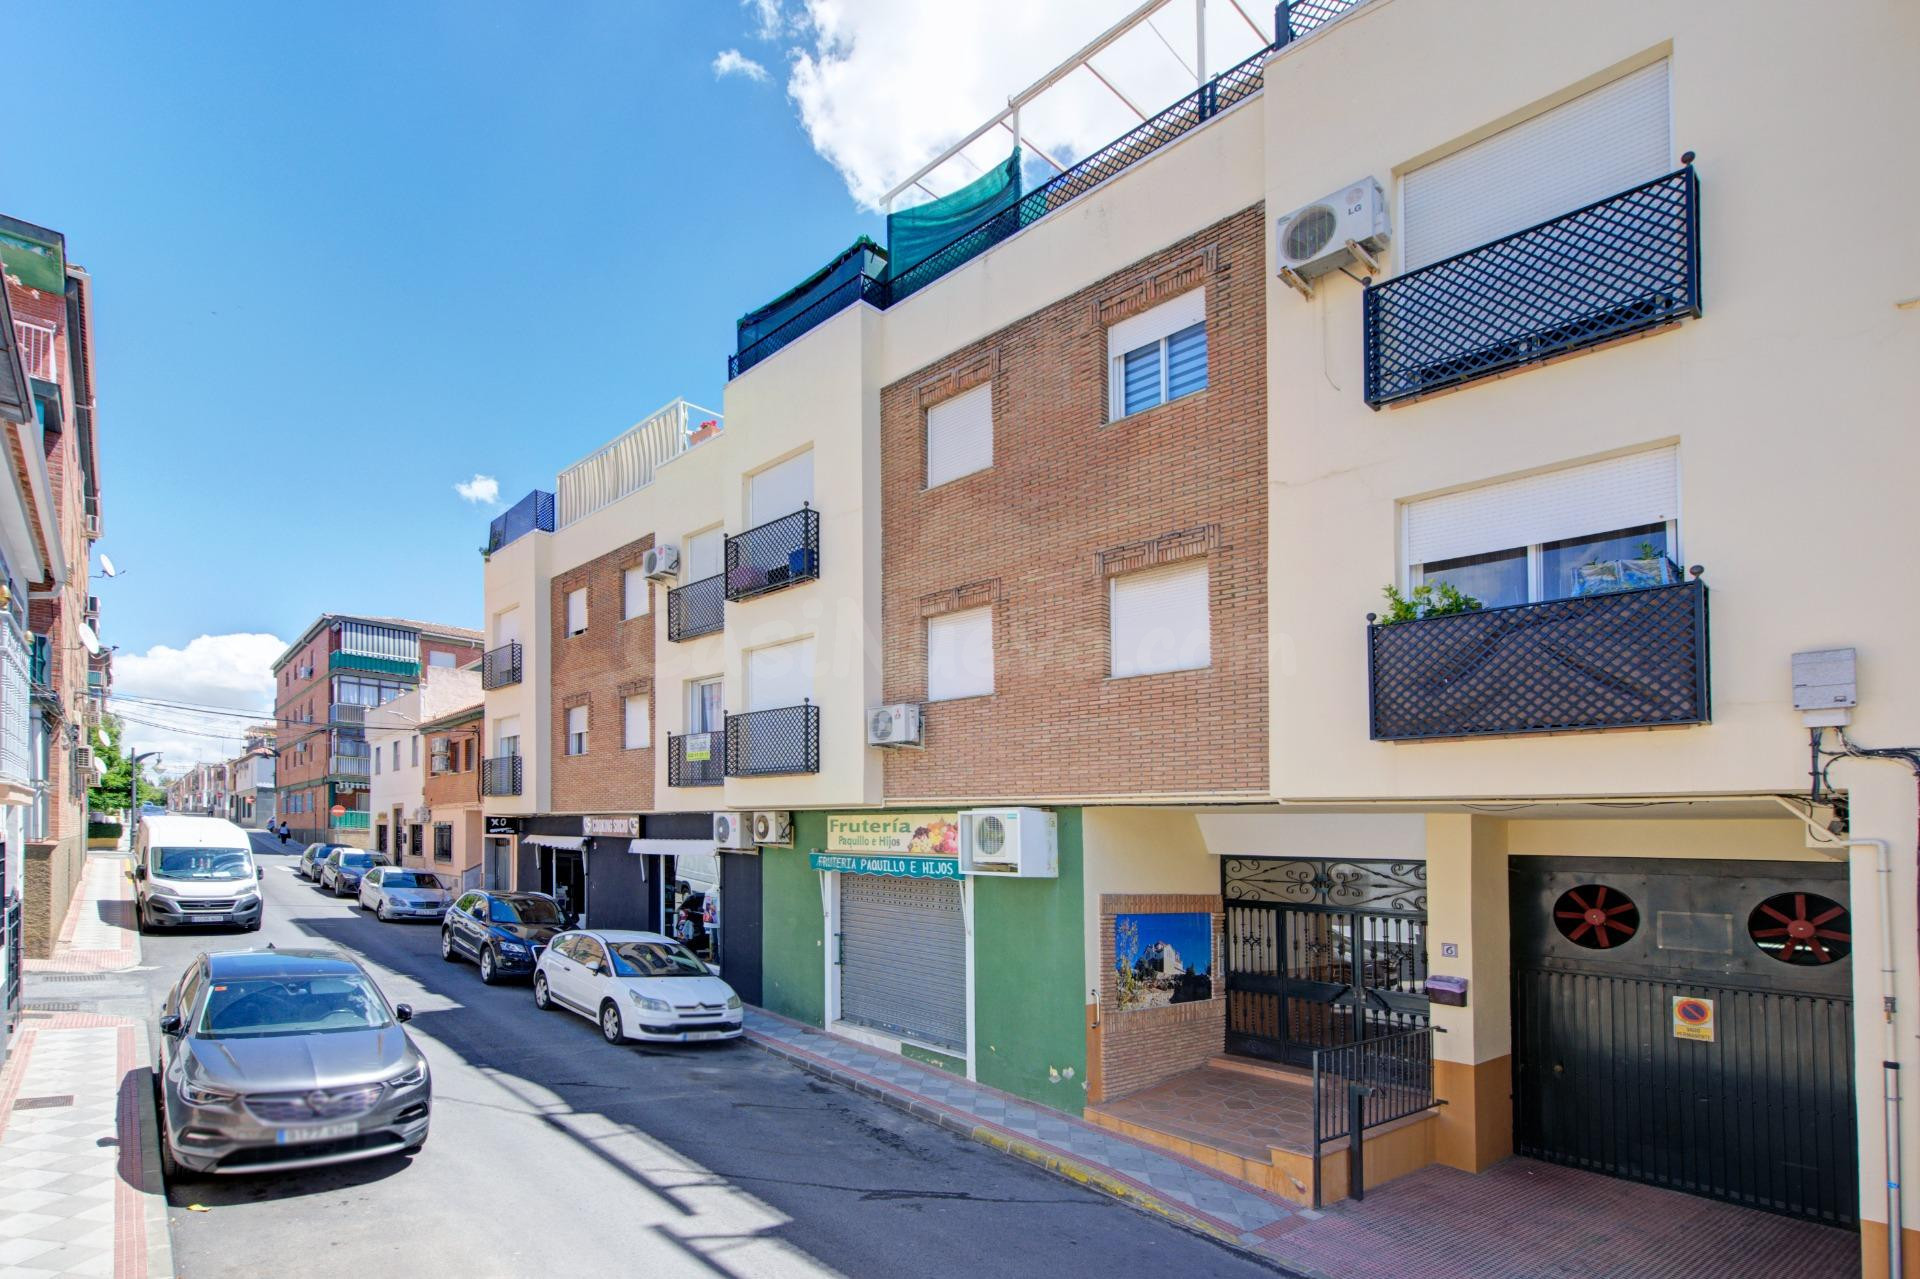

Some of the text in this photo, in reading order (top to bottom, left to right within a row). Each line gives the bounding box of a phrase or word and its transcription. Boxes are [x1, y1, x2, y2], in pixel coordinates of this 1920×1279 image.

[1347, 203, 1362, 216] LG
[830, 817, 912, 833] Frutería
[838, 835, 901, 849] Paquillo e Hijos
[817, 855, 954, 875] FRUTERIA PAQUILLO E HIJOS
[1445, 946, 1454, 955] 6
